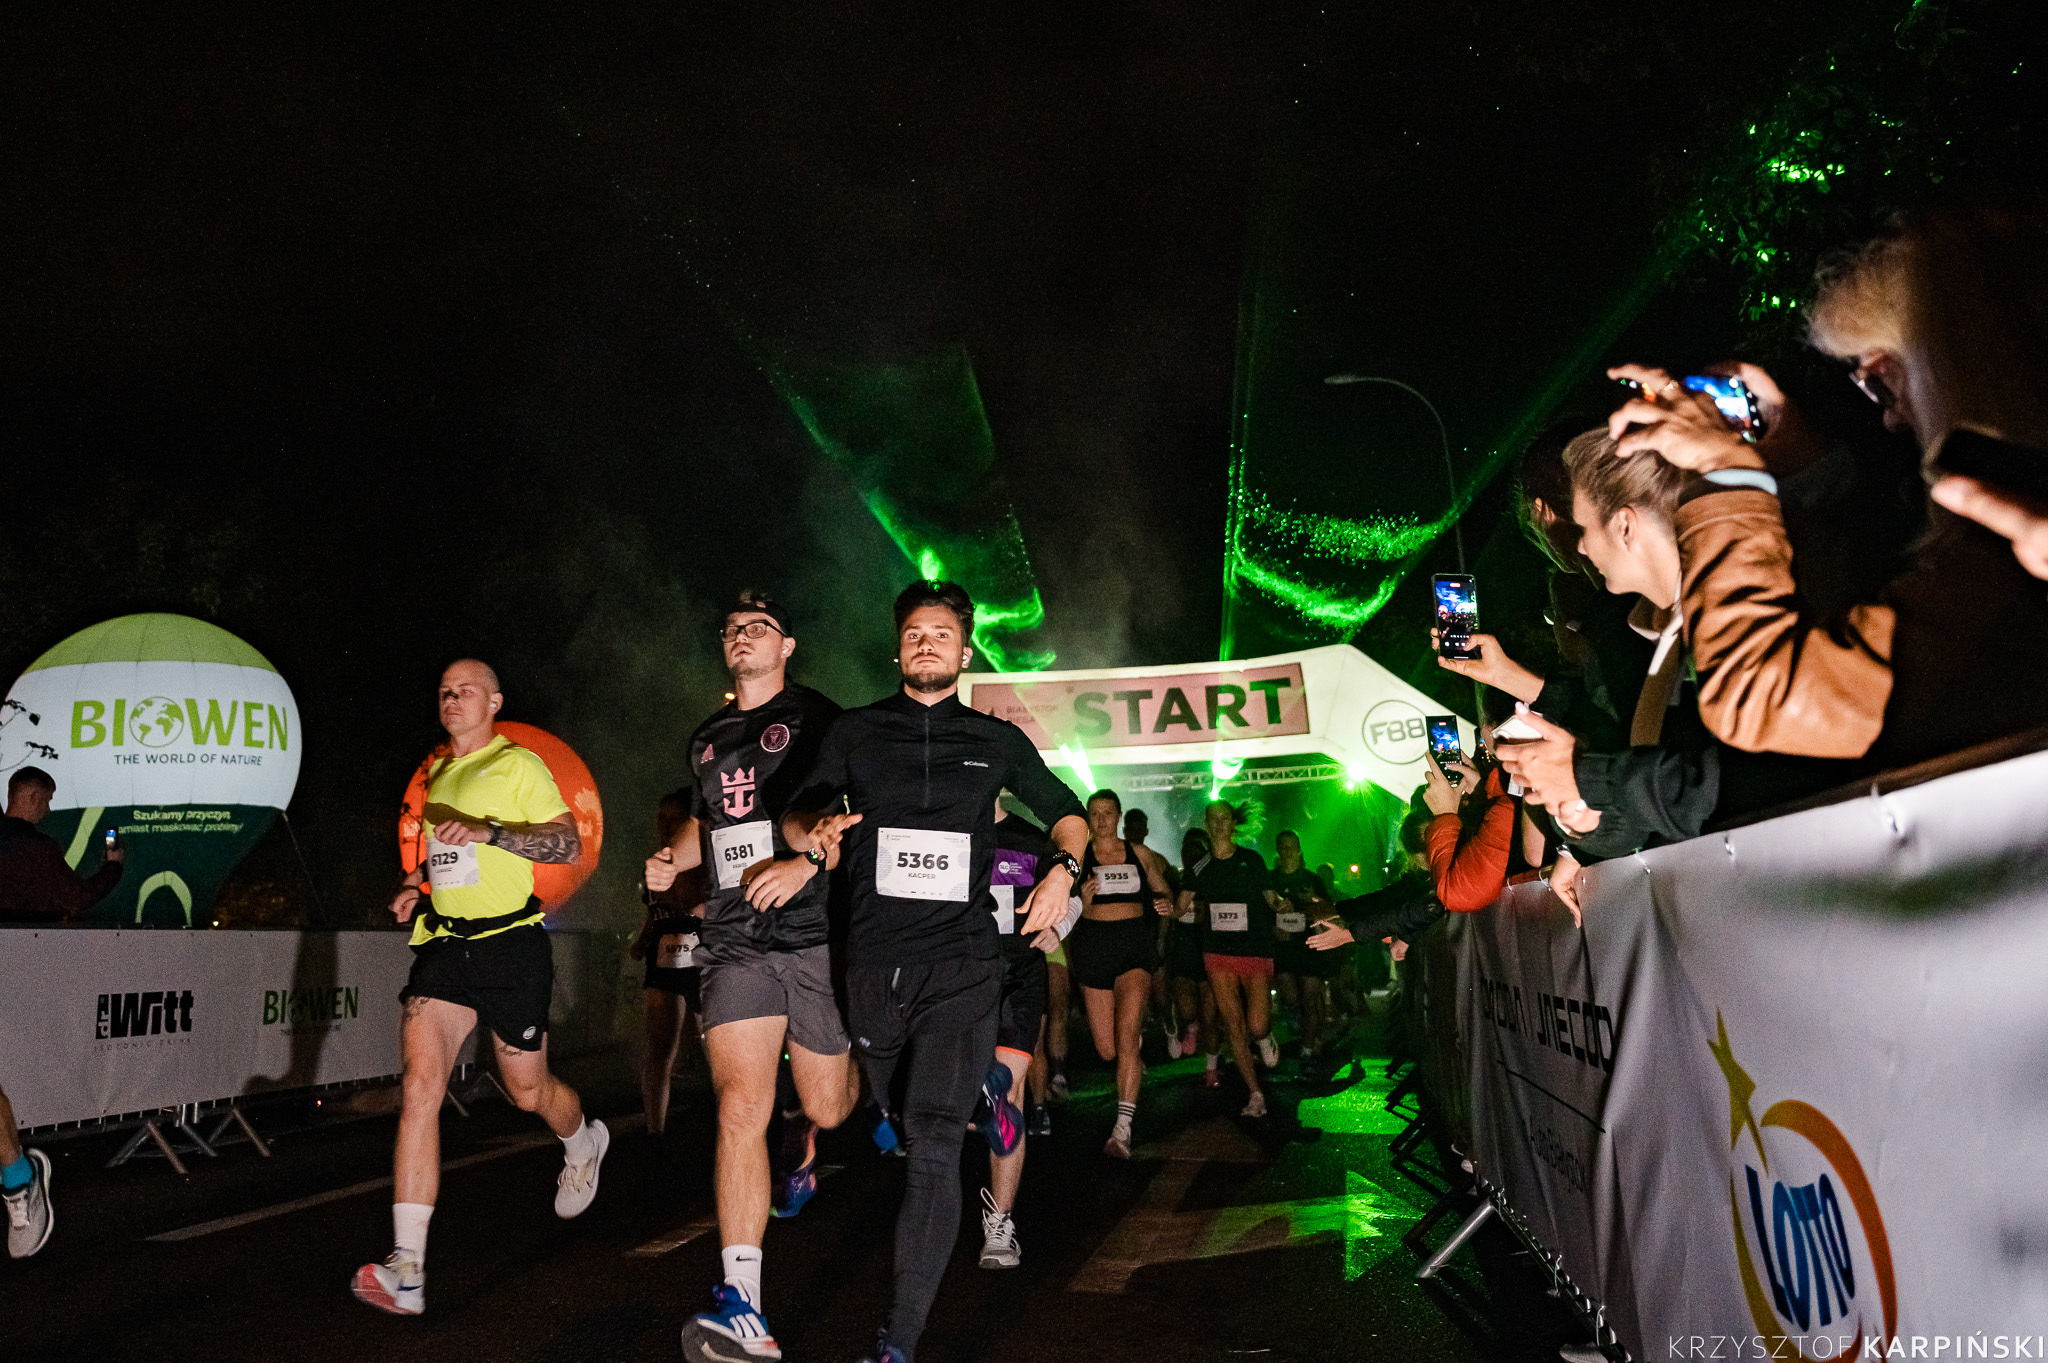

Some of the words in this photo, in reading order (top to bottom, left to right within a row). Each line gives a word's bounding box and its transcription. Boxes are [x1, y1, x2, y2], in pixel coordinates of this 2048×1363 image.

[1073, 677, 1291, 737] START
[1369, 718, 1426, 745] F88
[114, 754, 140, 765] THE
[145, 753, 196, 764] WORLD
[201, 753, 217, 764] OF
[221, 754, 262, 766] NATURE
[133, 809, 185, 821] Szukamy
[118, 823, 149, 834] amiast
[431, 851, 459, 867] 6129
[725, 843, 754, 862] 6381
[897, 852, 949, 871] 5366
[908, 872, 936, 880] KACPER
[1105, 872, 1129, 880] 5935
[110, 990, 194, 1039] Witt
[1746, 1164, 1855, 1332] LOTTO
